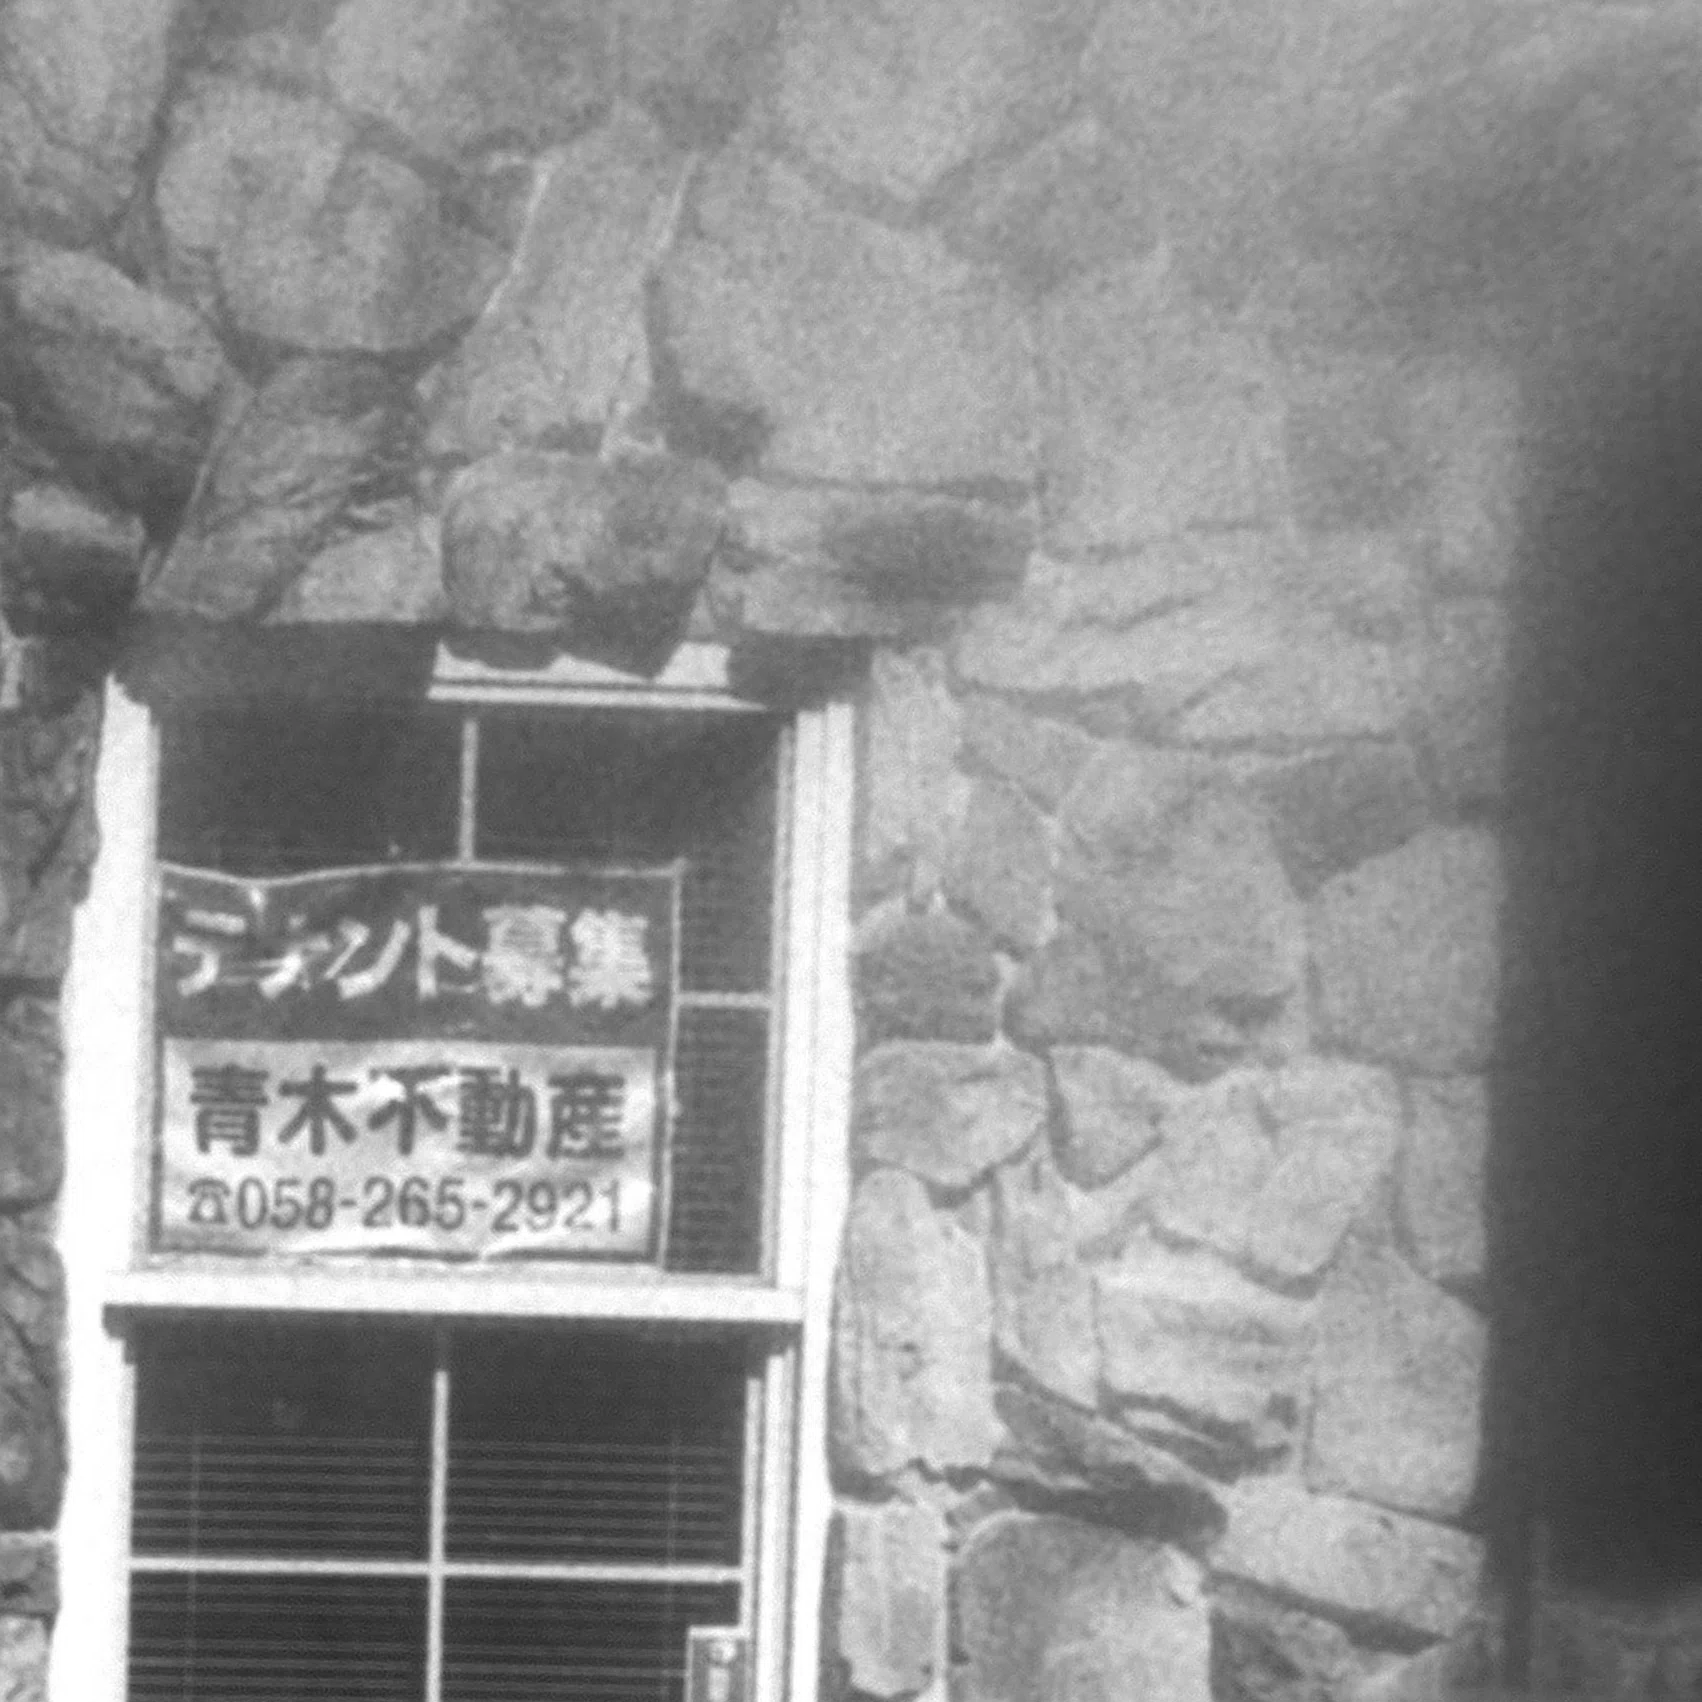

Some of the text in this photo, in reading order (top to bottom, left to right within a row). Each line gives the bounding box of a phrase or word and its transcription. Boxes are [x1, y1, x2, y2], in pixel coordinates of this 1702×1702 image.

[190, 1064, 626, 1161] 青木不動産
